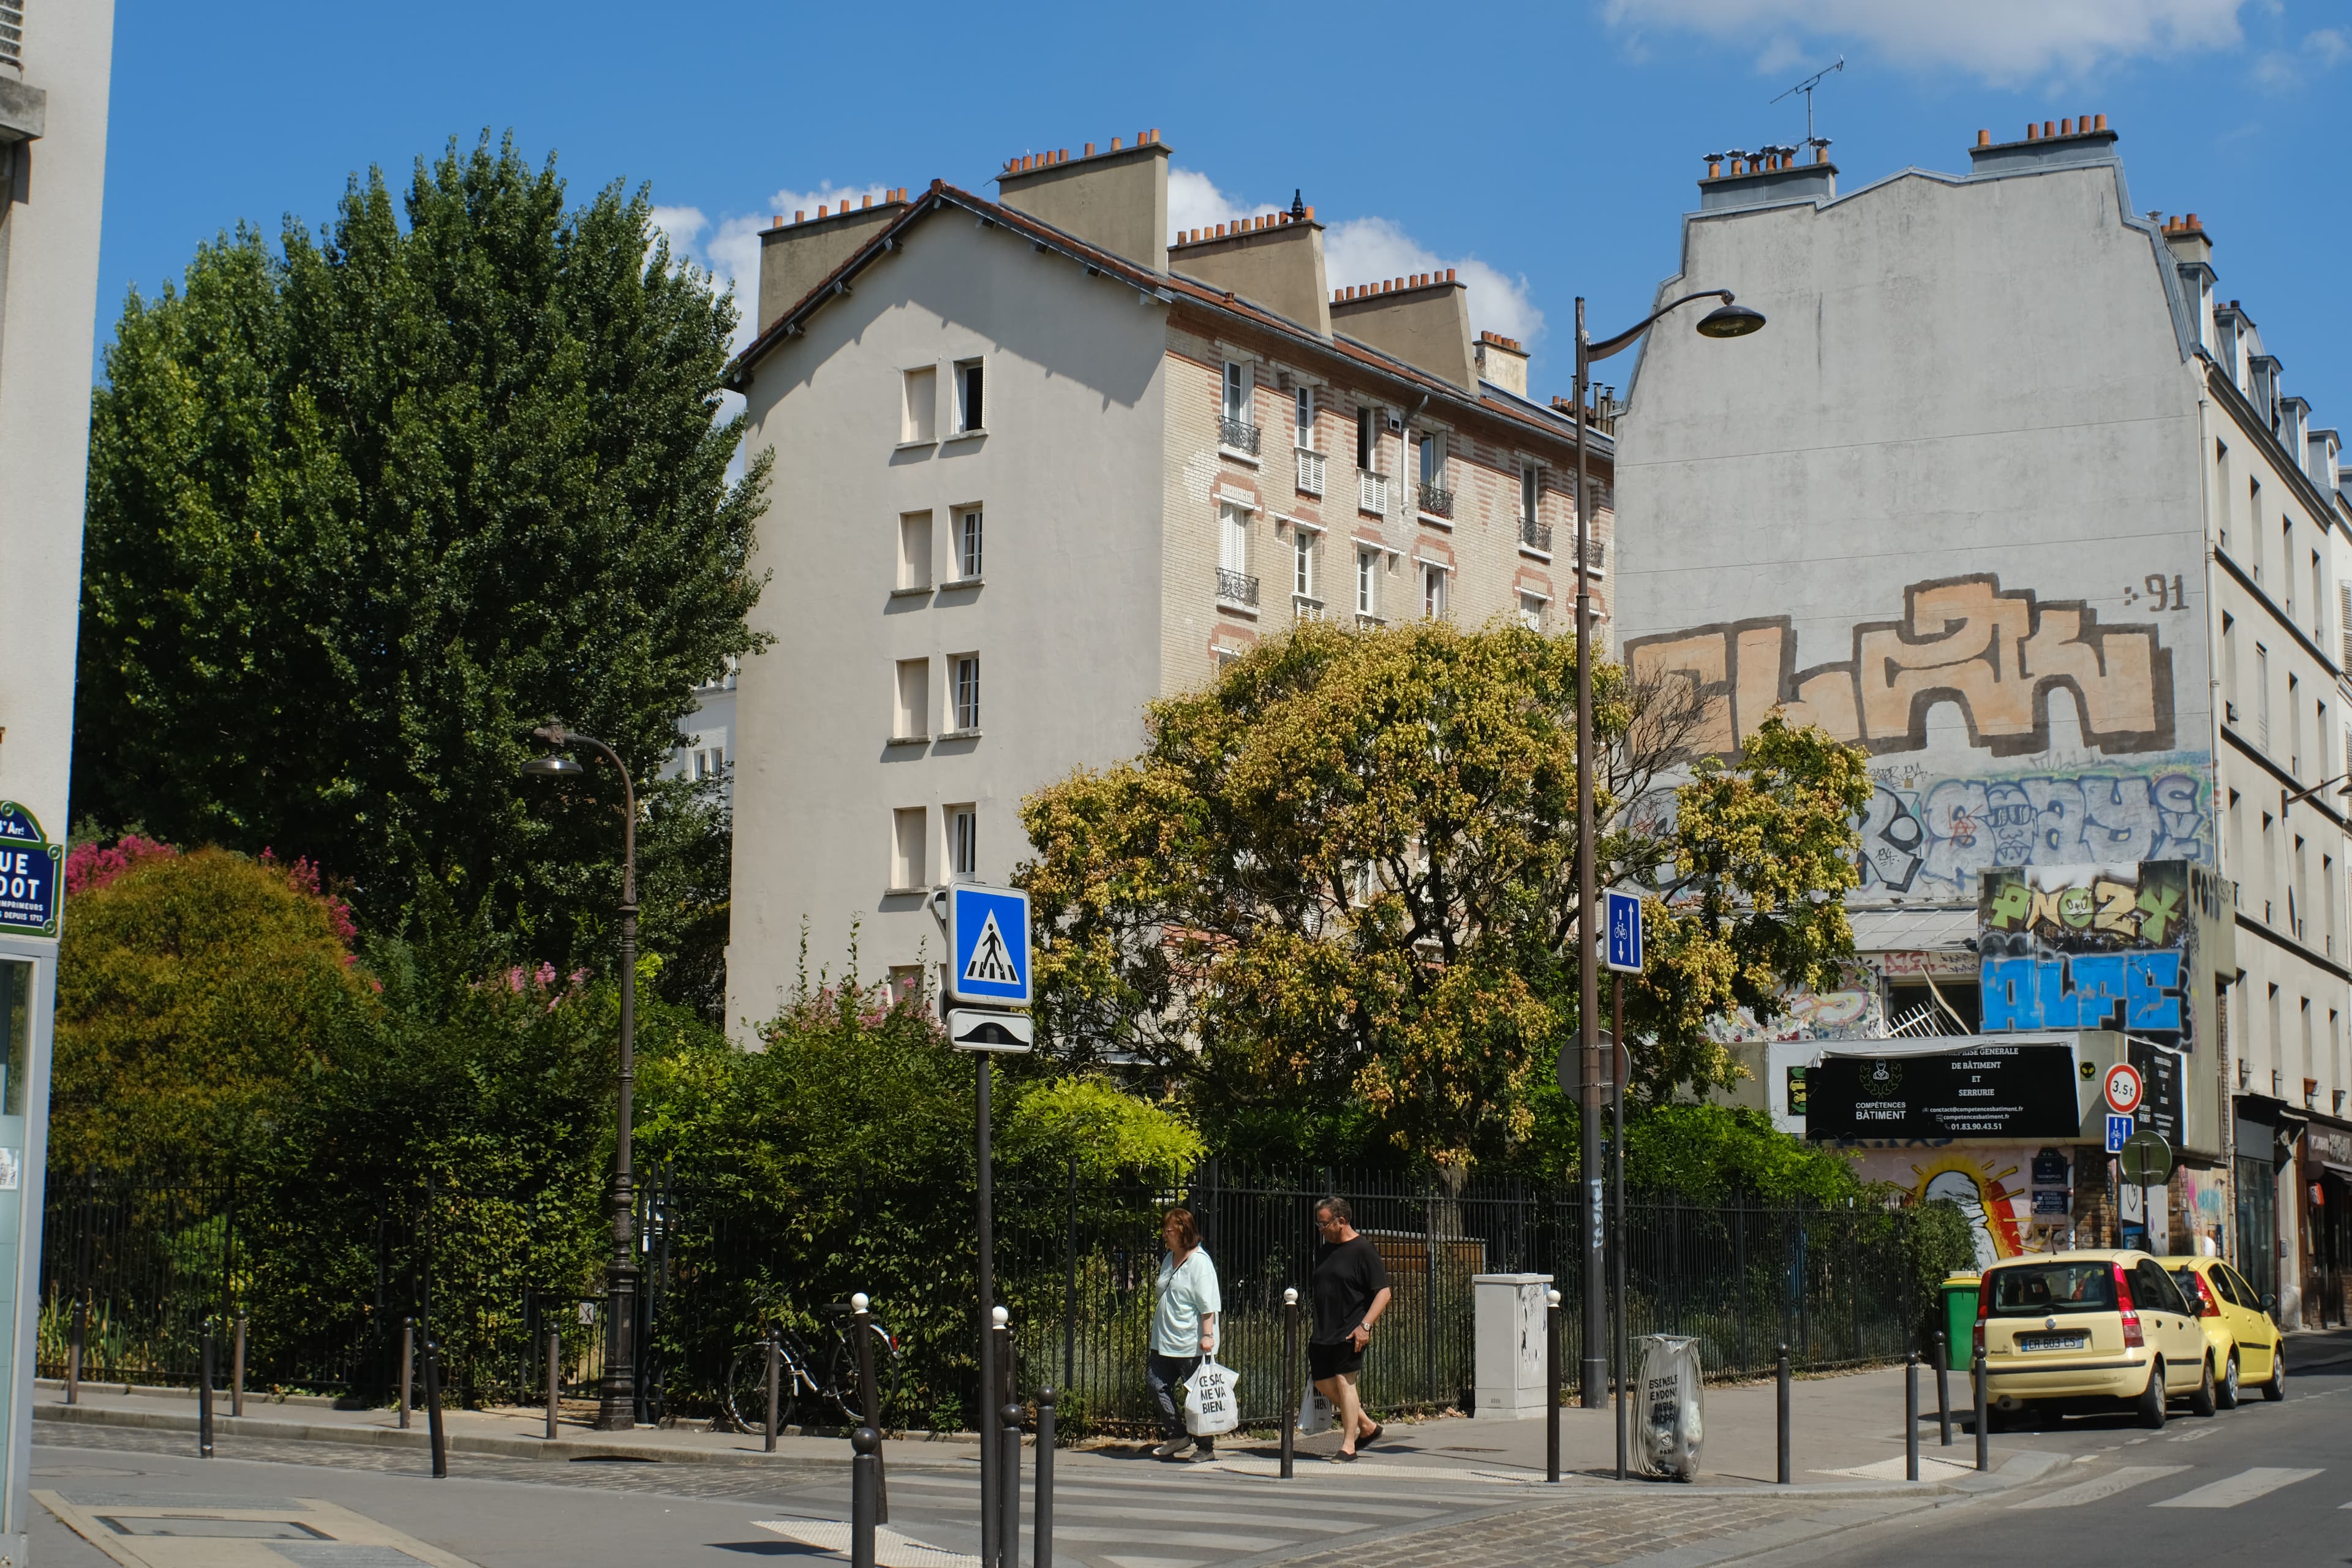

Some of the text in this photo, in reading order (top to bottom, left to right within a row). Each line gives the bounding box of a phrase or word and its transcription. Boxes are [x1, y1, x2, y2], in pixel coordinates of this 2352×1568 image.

[2145, 573, 2190, 611] 91
[4, 911, 28, 921] DEPUIS
[1962, 1060, 2002, 1069] BÂTIMENT
[1856, 1109, 1906, 1120] BÂTIMENT
[1199, 1373, 1225, 1387] CE SAC
[1200, 1387, 1226, 1401] ME VA
[1202, 1400, 1226, 1414] BIEN.
